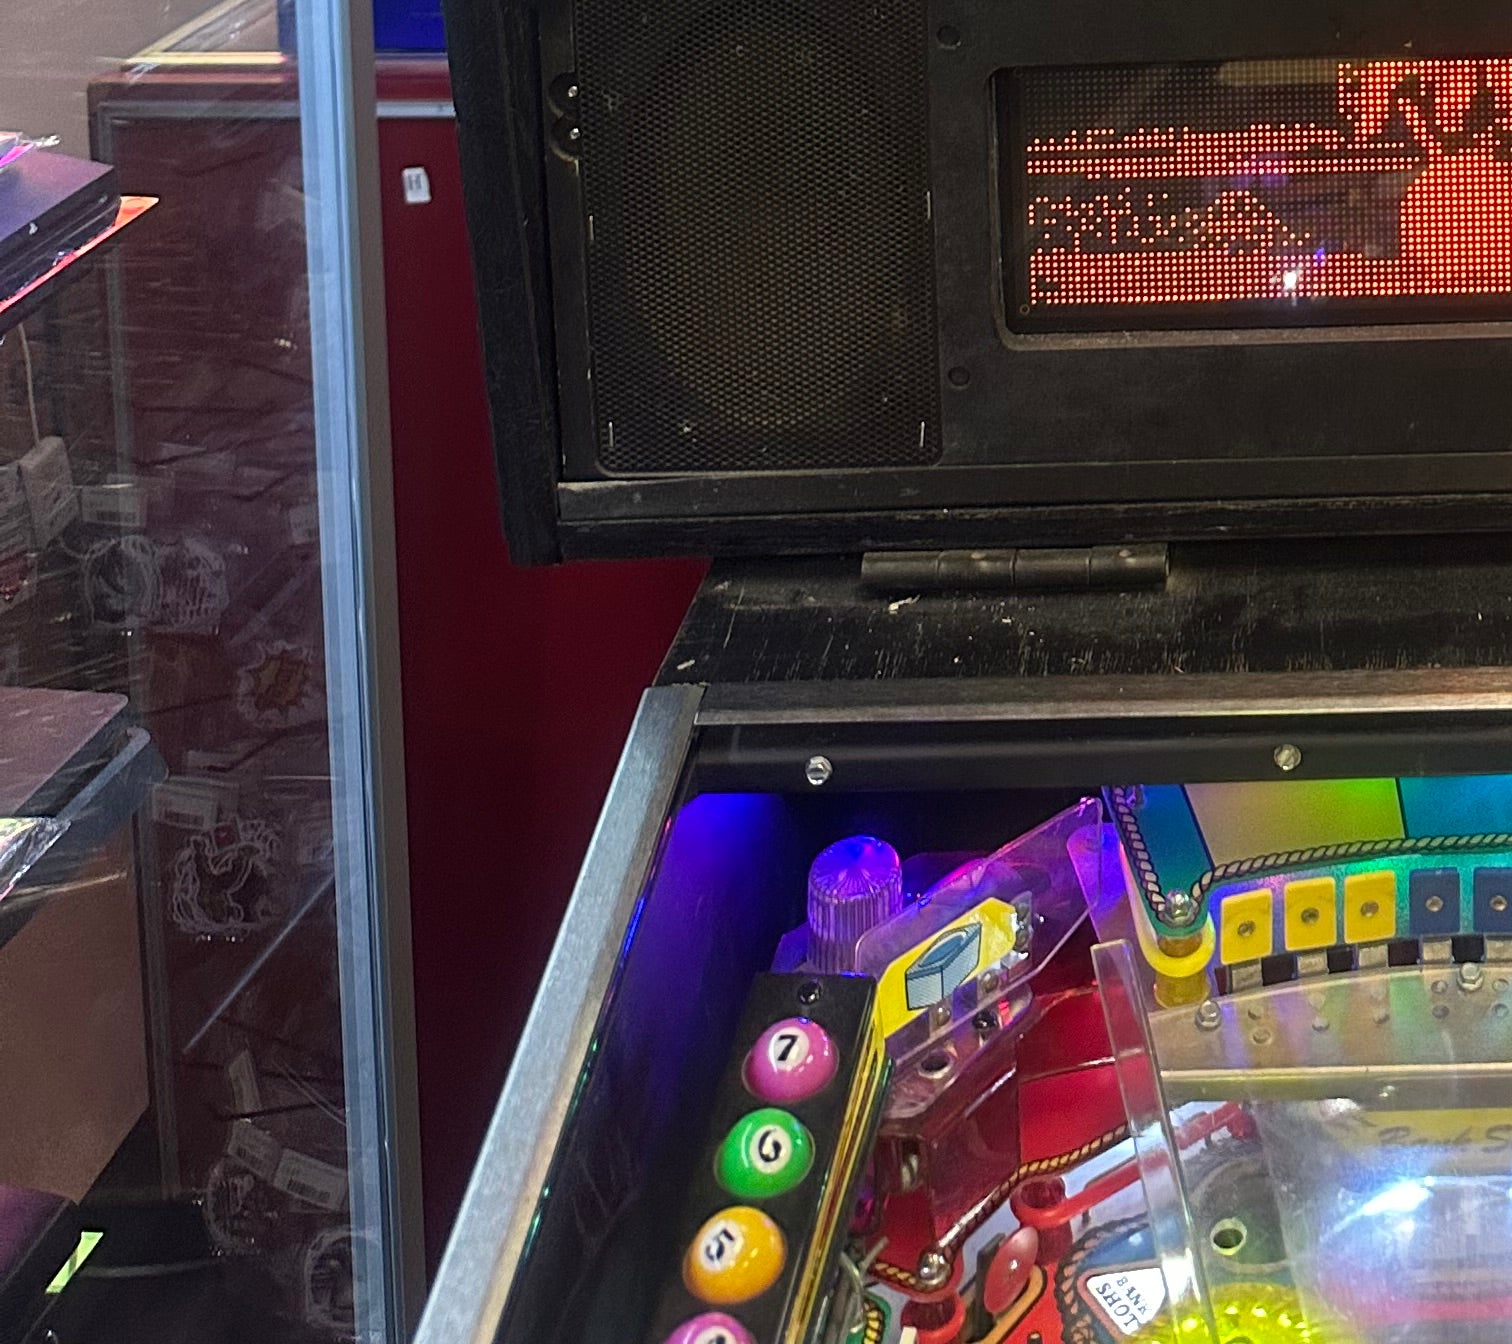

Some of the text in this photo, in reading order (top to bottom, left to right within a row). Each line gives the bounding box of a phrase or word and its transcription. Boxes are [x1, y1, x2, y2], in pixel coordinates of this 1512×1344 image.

[777, 1033, 799, 1062] 7
[757, 1128, 783, 1163] 6
[705, 1227, 735, 1263] 5
[1095, 1282, 1141, 1327] SHOT
[1116, 1275, 1151, 1316] BANK
